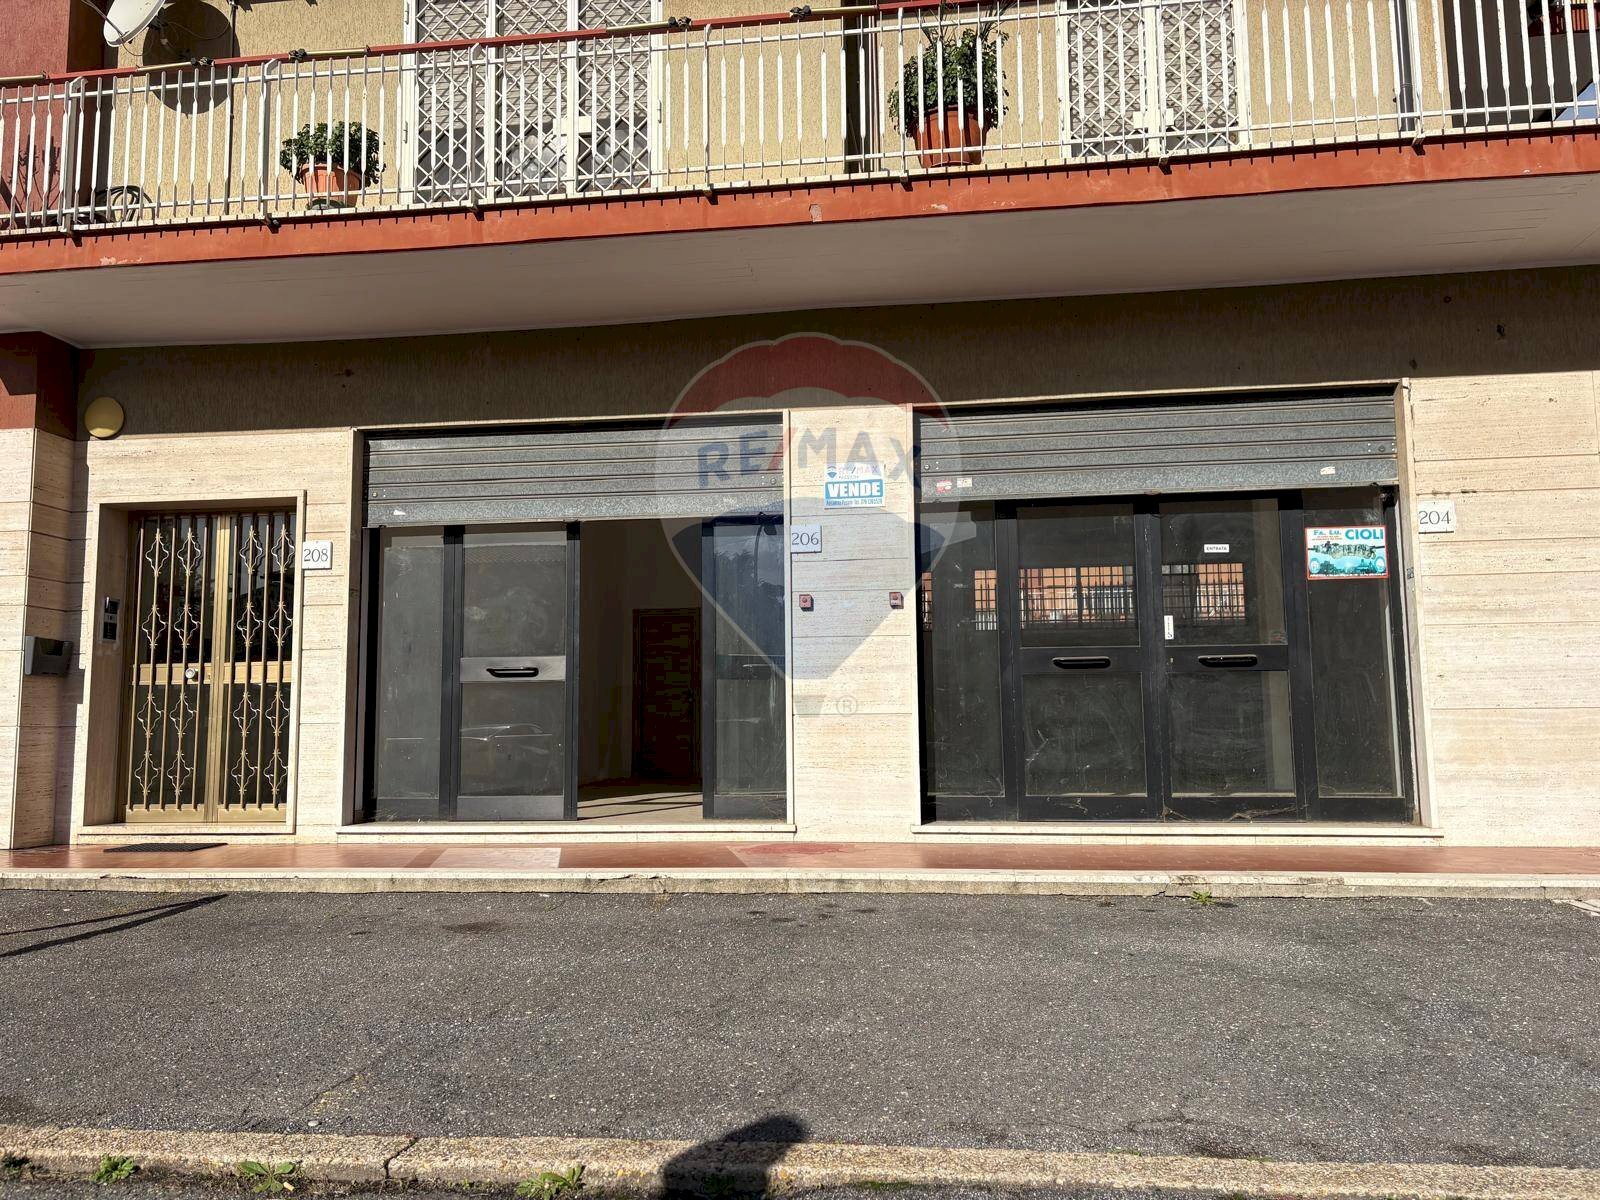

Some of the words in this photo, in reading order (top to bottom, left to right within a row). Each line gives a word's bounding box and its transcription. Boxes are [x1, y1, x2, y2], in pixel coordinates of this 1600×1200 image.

[828, 481, 881, 498] VENDE
[1418, 510, 1452, 525] 204
[791, 532, 819, 546] 206
[1345, 528, 1384, 540] CIOLI
[303, 548, 329, 563] 208
